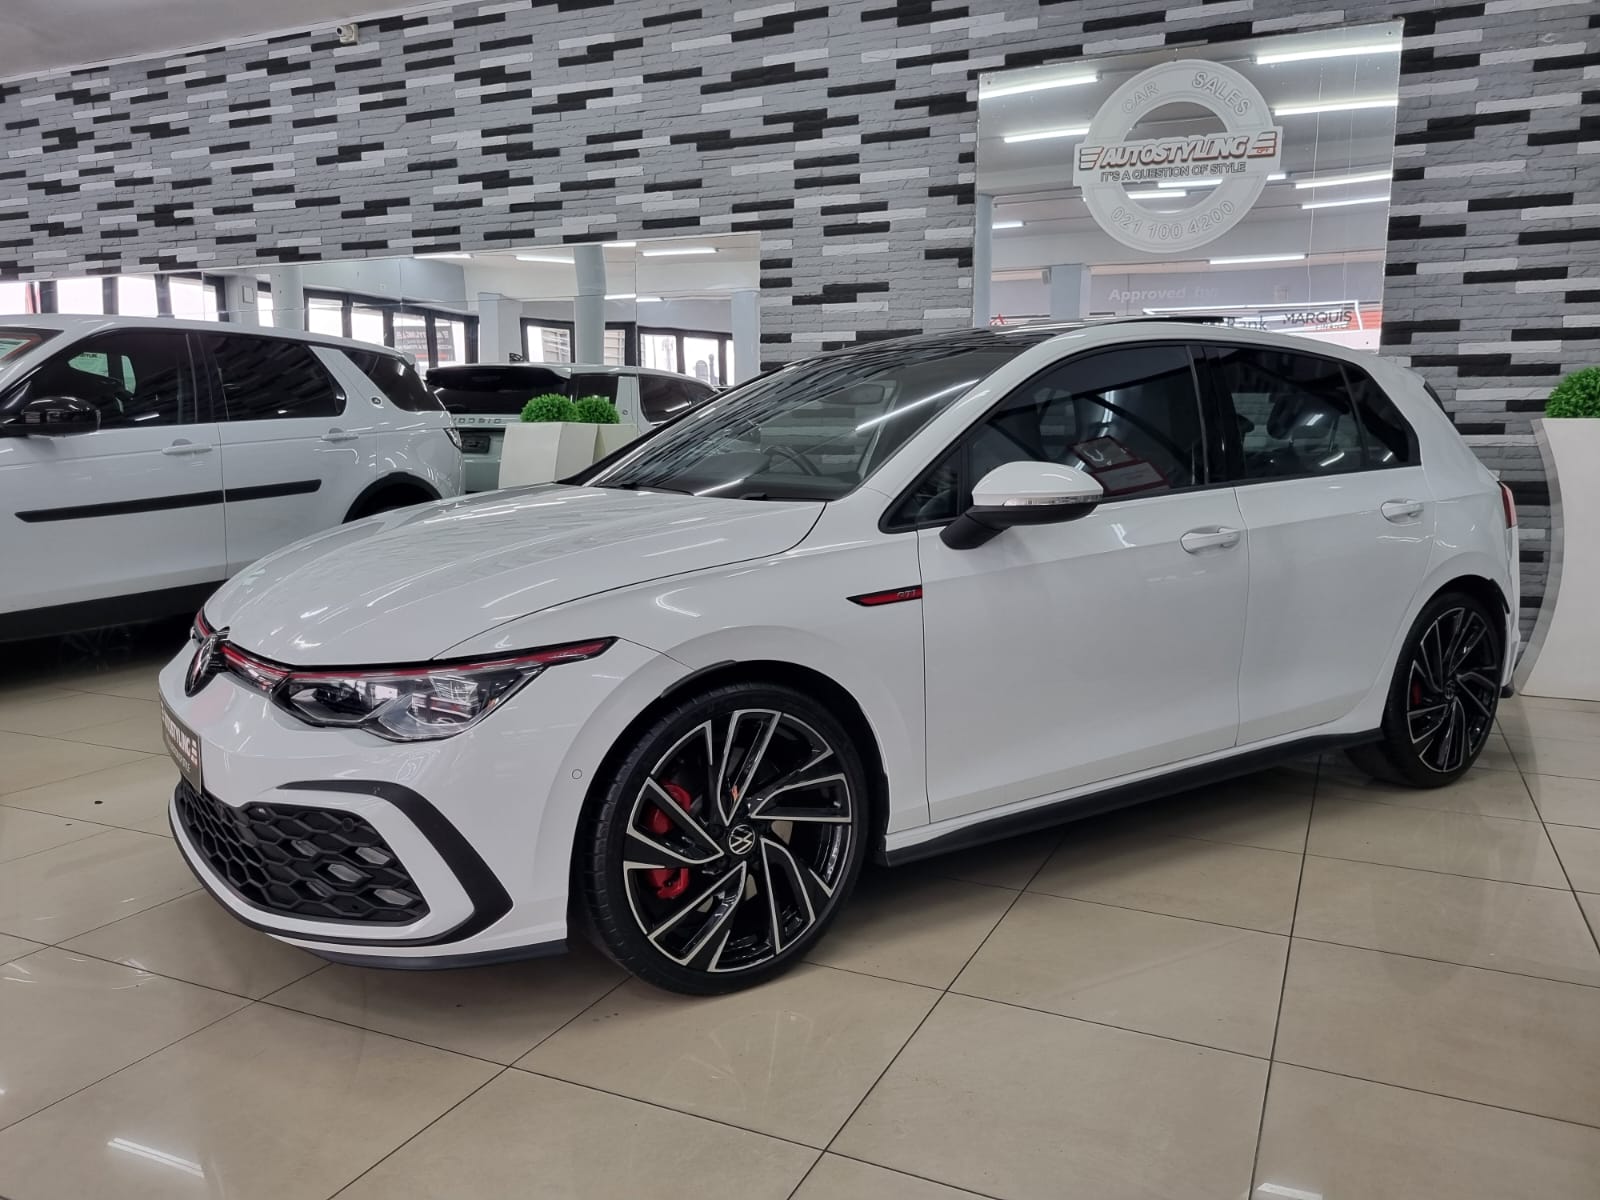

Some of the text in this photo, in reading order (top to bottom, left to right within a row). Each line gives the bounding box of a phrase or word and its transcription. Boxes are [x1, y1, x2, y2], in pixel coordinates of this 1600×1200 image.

[1122, 71, 1249, 115] CAR SALES
[1099, 135, 1250, 169] AUTOSTYLING
[1100, 161, 1247, 182] IT'S A QUESTION OF STYLE
[1111, 200, 1235, 240] 021 100 4200
[1108, 286, 1186, 303] Approved
[1282, 310, 1353, 325] MARQUIS
[896, 589, 917, 598] GTI
